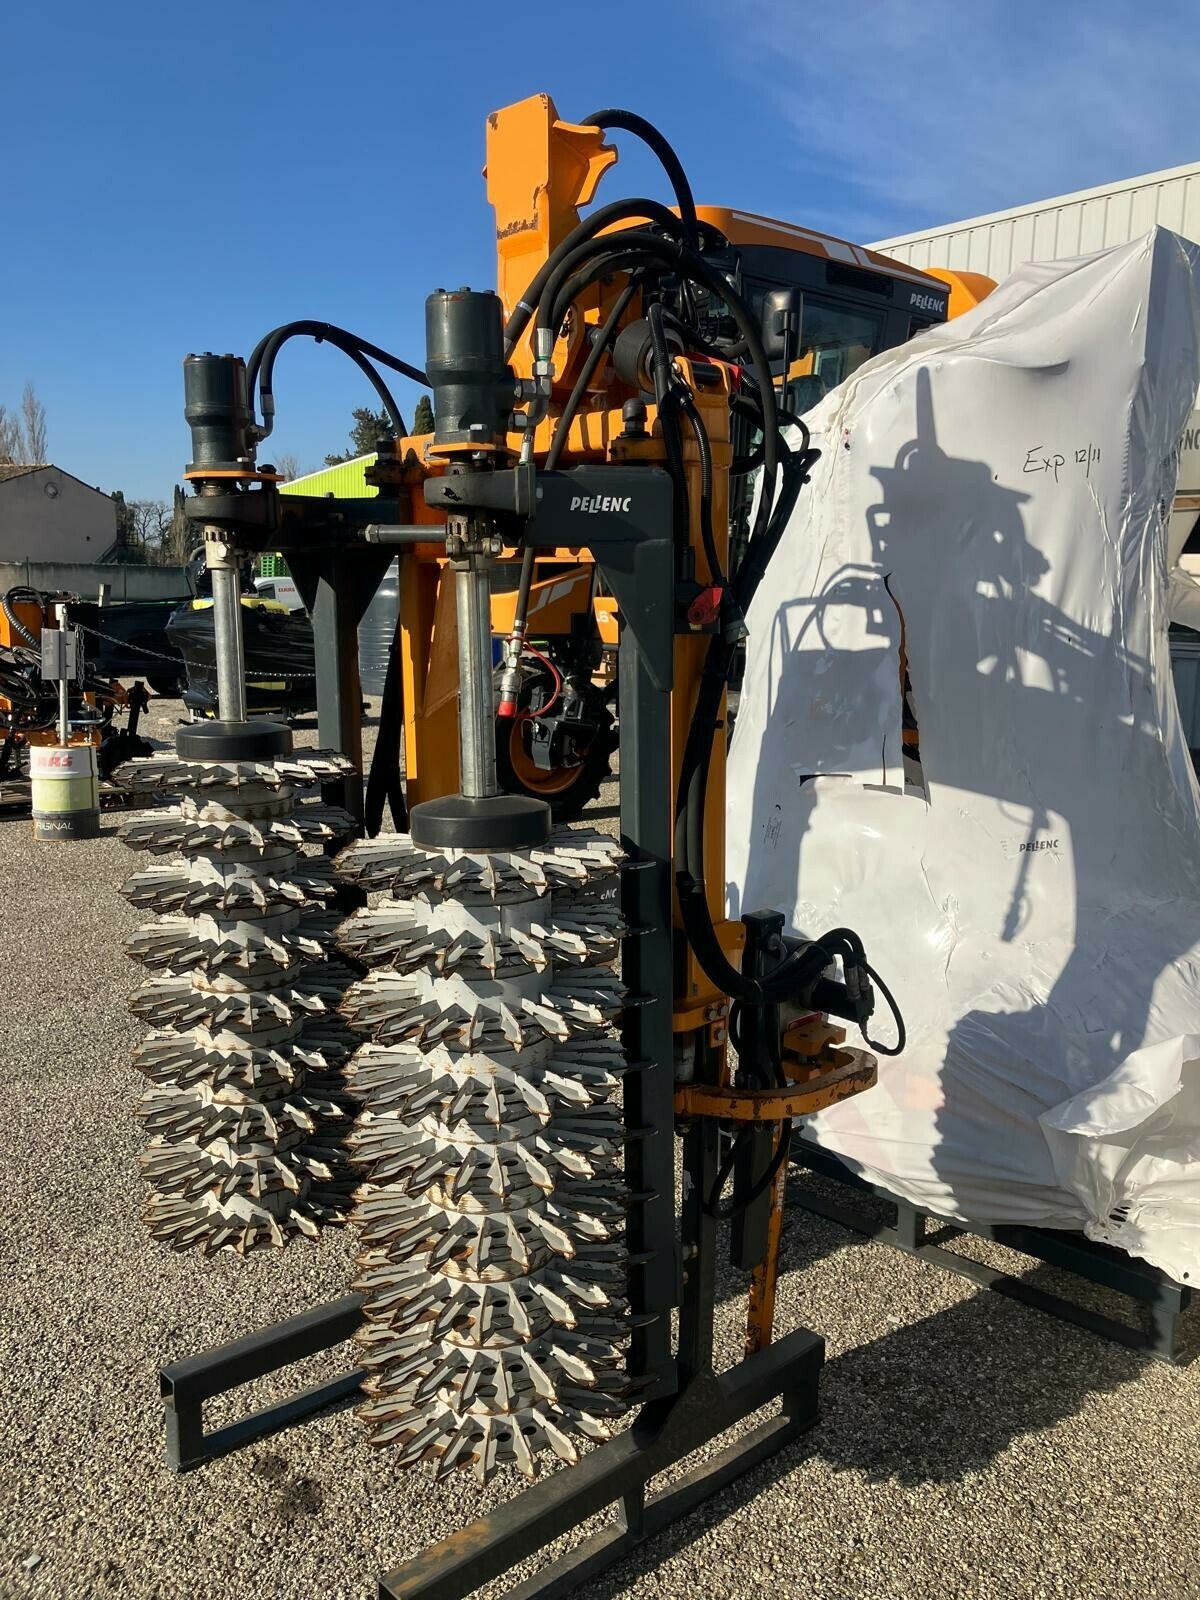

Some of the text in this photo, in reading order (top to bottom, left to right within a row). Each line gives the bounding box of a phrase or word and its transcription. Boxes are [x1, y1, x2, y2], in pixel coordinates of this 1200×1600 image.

[910, 293, 945, 312] PELLENC
[1023, 443, 1101, 483] Exp 12/11
[570, 495, 632, 513] PELLENC
[1019, 839, 1060, 853] PELLENC
